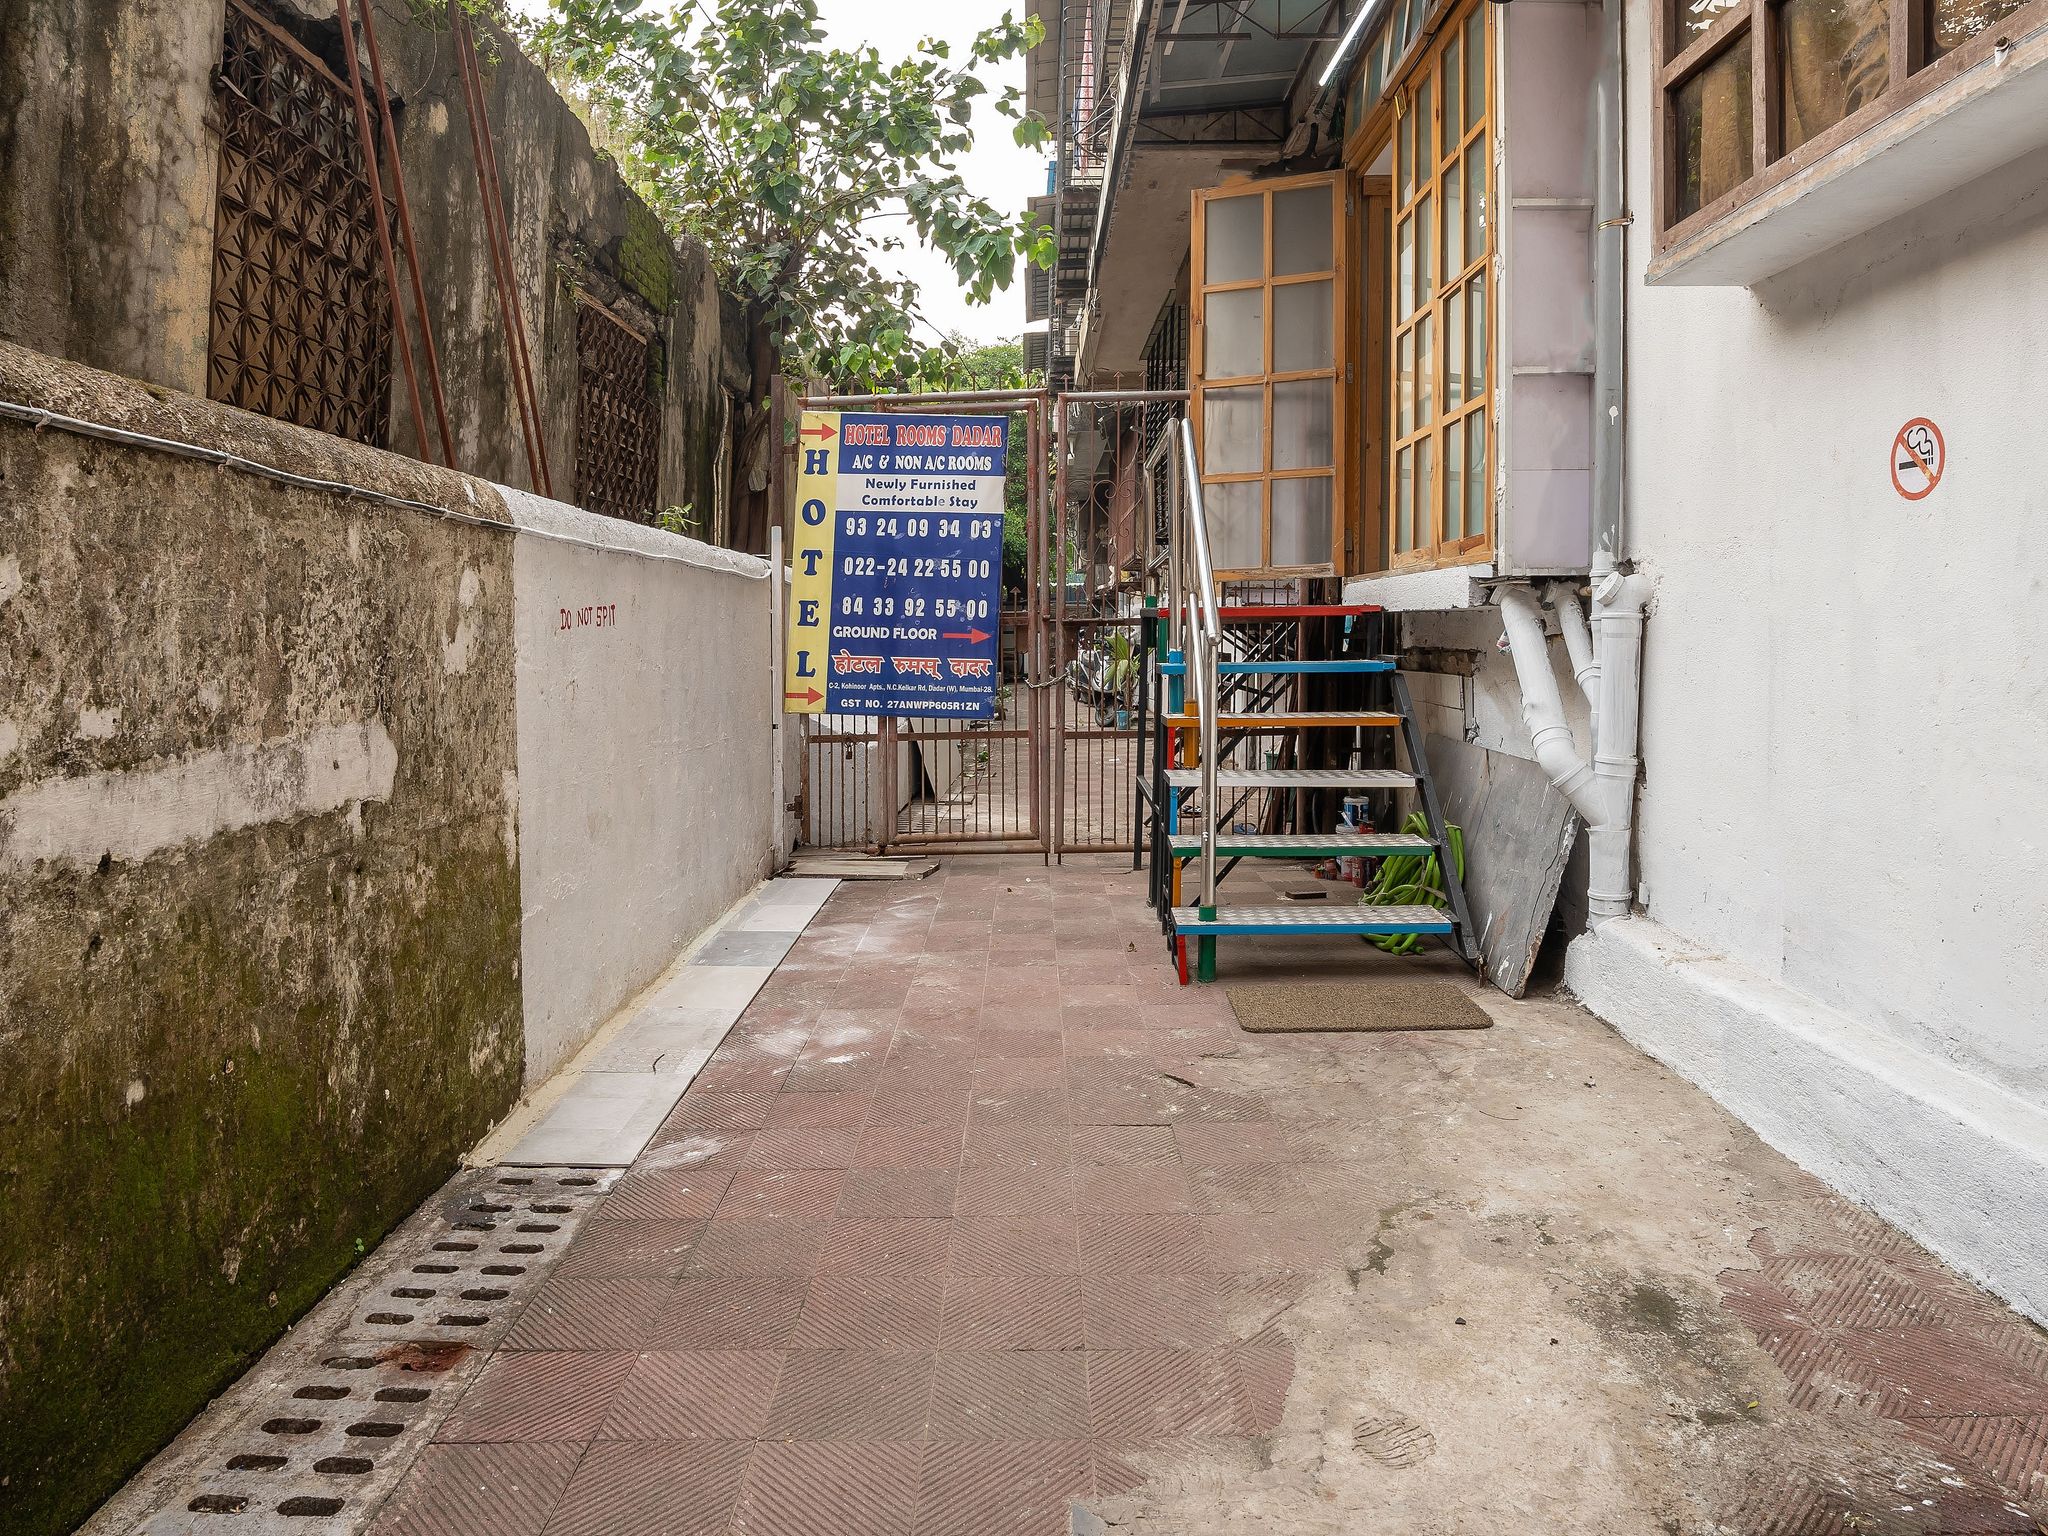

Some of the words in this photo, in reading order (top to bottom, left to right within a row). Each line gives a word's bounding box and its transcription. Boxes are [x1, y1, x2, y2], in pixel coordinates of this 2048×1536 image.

[844, 424, 890, 446] HOTEL
[896, 425, 946, 447] ROOMS
[951, 425, 1002, 448] DADAR
[852, 454, 873, 470] A/C
[879, 455, 890, 469] &
[895, 455, 922, 471] NON
[924, 456, 946, 471] A/C
[947, 456, 992, 471] ROOMS
[865, 478, 907, 491] Newly
[910, 479, 976, 491] Furnished
[862, 494, 946, 507] Comfortable
[949, 495, 979, 509] Stay
[845, 517, 867, 536] 93
[876, 518, 898, 537] 24
[907, 519, 929, 537] 09
[938, 519, 961, 538] 34
[970, 520, 992, 539] 03
[844, 557, 908, 577] 022-24
[914, 558, 935, 577] 22
[940, 559, 962, 578] 55
[968, 560, 990, 579] 00
[842, 596, 864, 615] 84
[873, 597, 895, 617] 33
[904, 598, 925, 617] 92
[935, 599, 957, 618] 55
[966, 599, 989, 619] 00
[560, 608, 572, 631] DO
[577, 606, 593, 628] NOT
[832, 625, 891, 640] GROUND
[893, 627, 938, 641] FLOOR
[832, 649, 885, 674] होटल
[947, 658, 993, 678] दादर
[841, 682, 867, 691] Kohinoor
[928, 685, 947, 693] Dadar
[840, 699, 861, 708] GST
[865, 699, 883, 708] NO.
